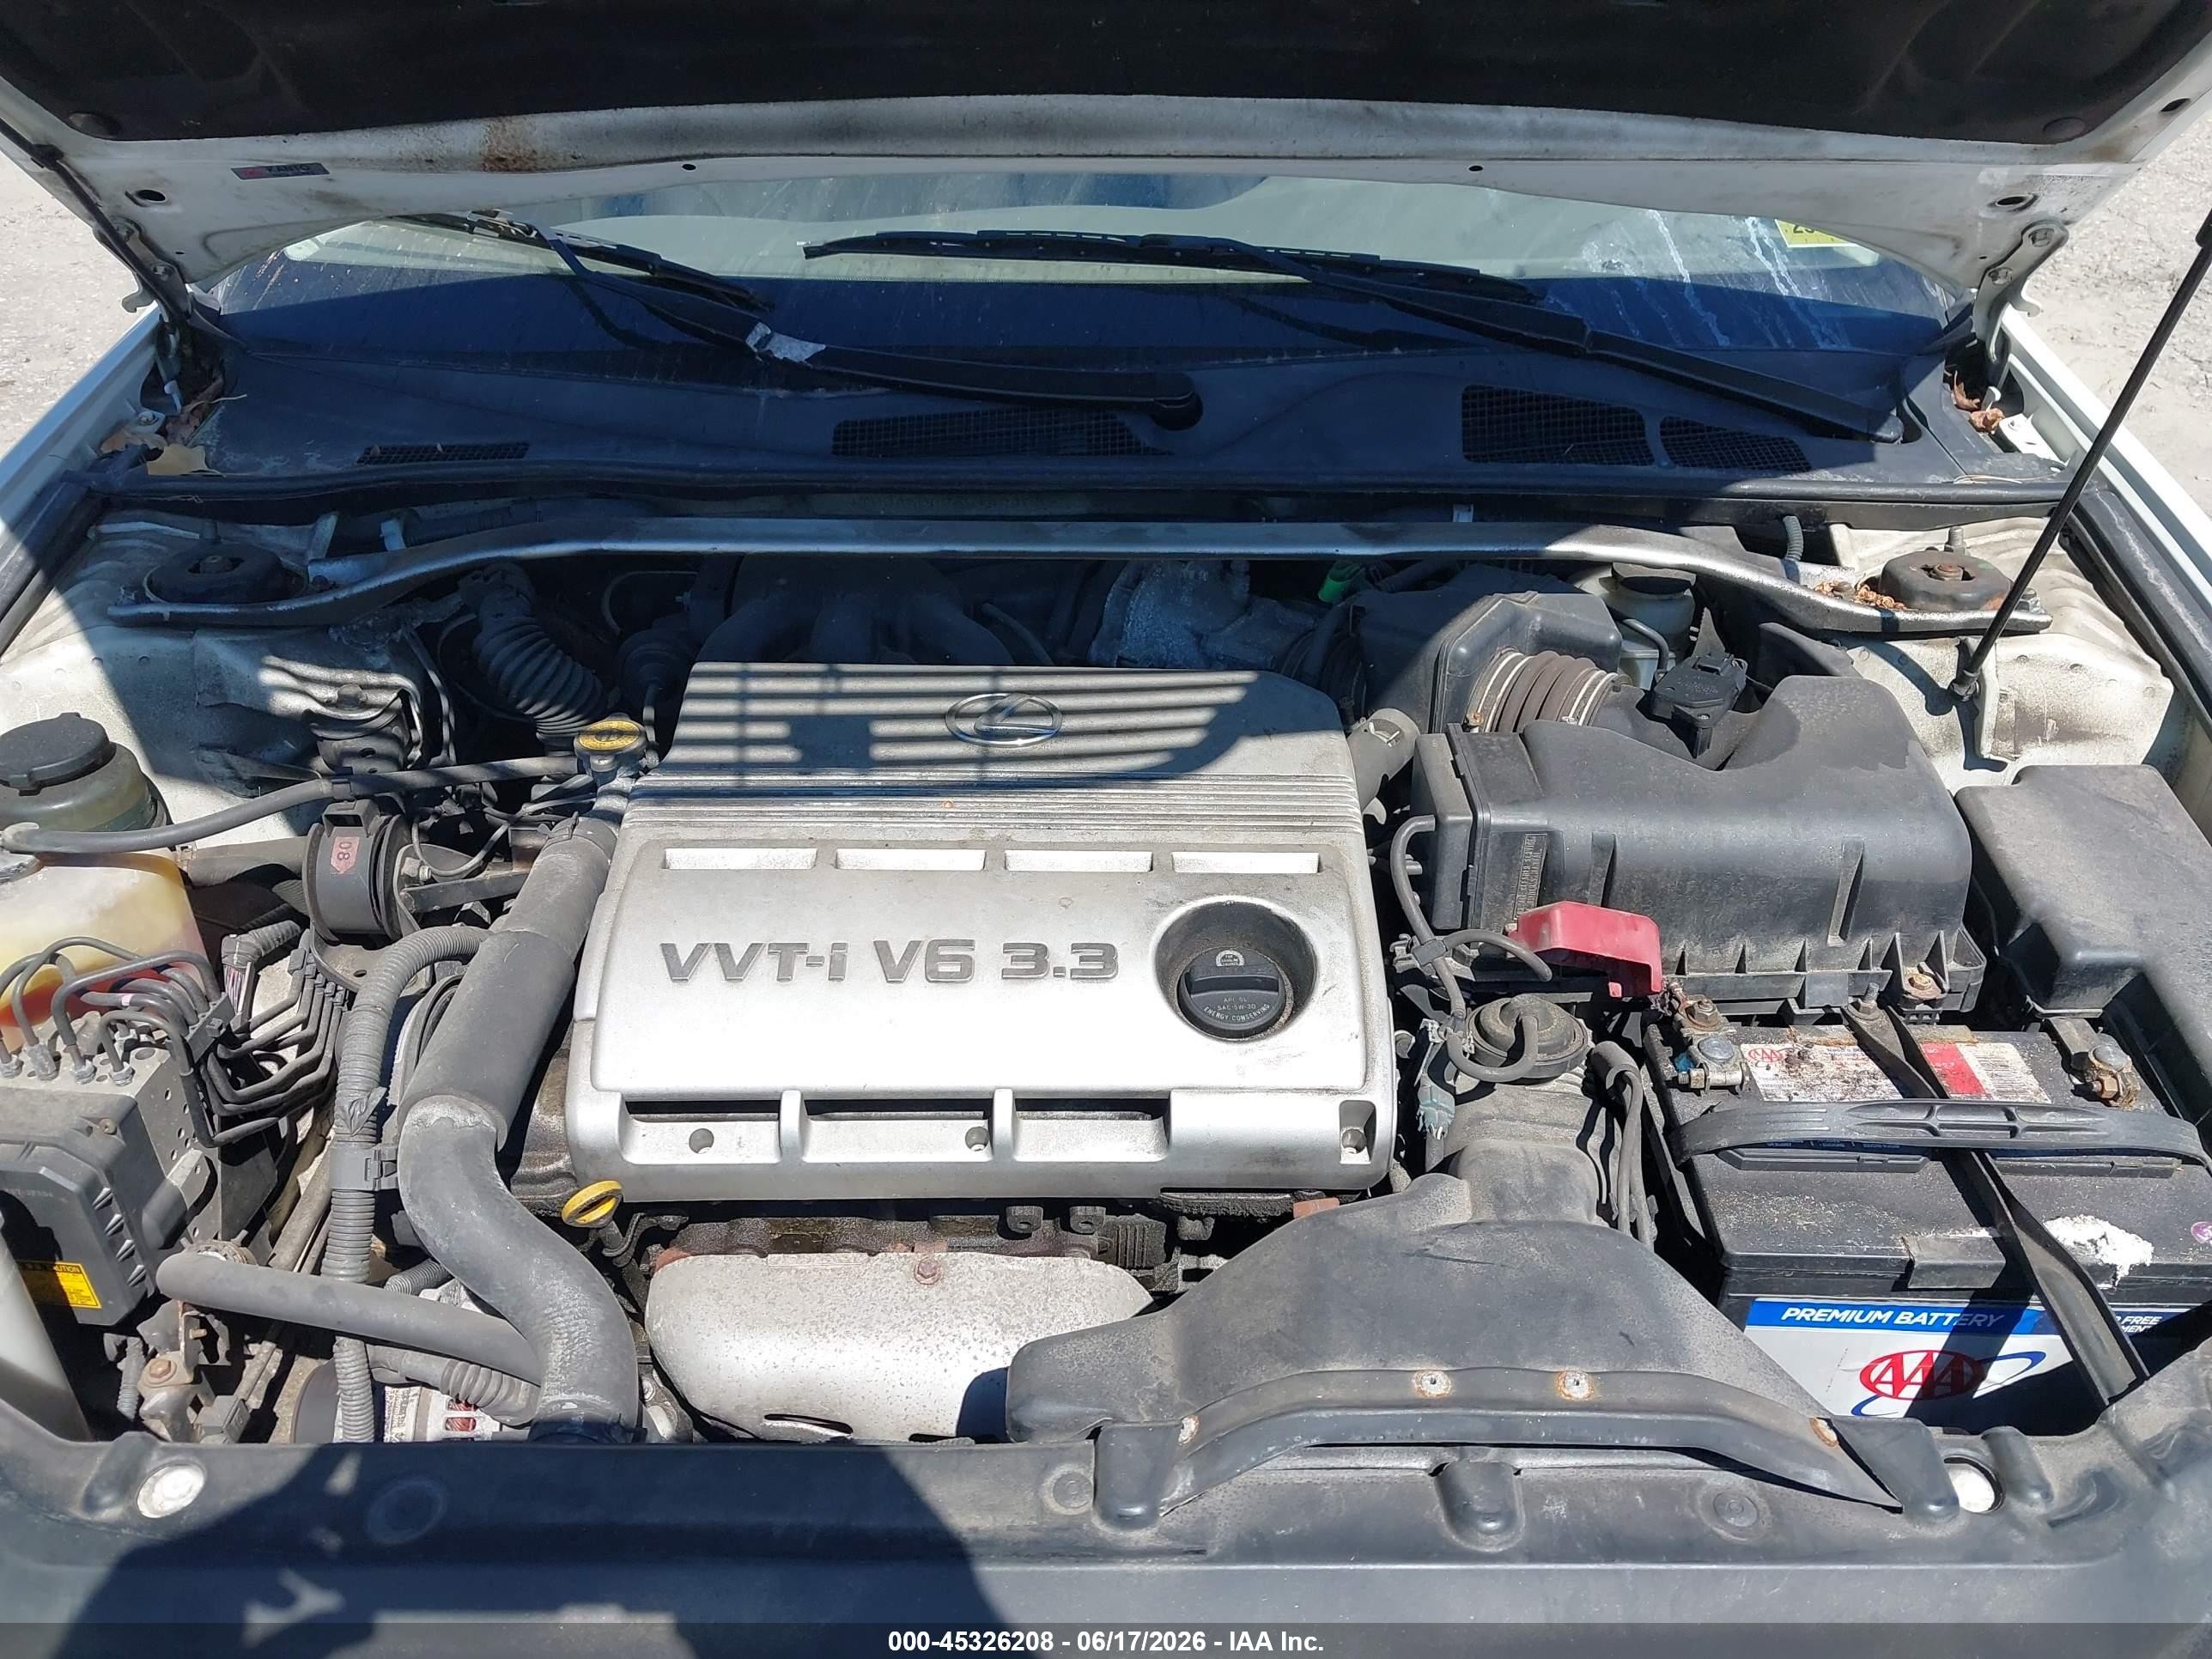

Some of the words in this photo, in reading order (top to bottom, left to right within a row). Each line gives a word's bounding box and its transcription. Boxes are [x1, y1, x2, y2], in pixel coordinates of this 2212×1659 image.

[660, 942, 848, 982] VVT-i
[872, 939, 976, 983] V6
[1002, 942, 1119, 981] 3.3
[1203, 1006, 1229, 1020] ENERGY
[1231, 1003, 1270, 1021] CONSERVING
[1780, 1307, 1892, 1325] PREMIUM
[1893, 1310, 2004, 1328] BATTERY
[2121, 1316, 2163, 1325] FREE
[1868, 1350, 1976, 1401] AAA
